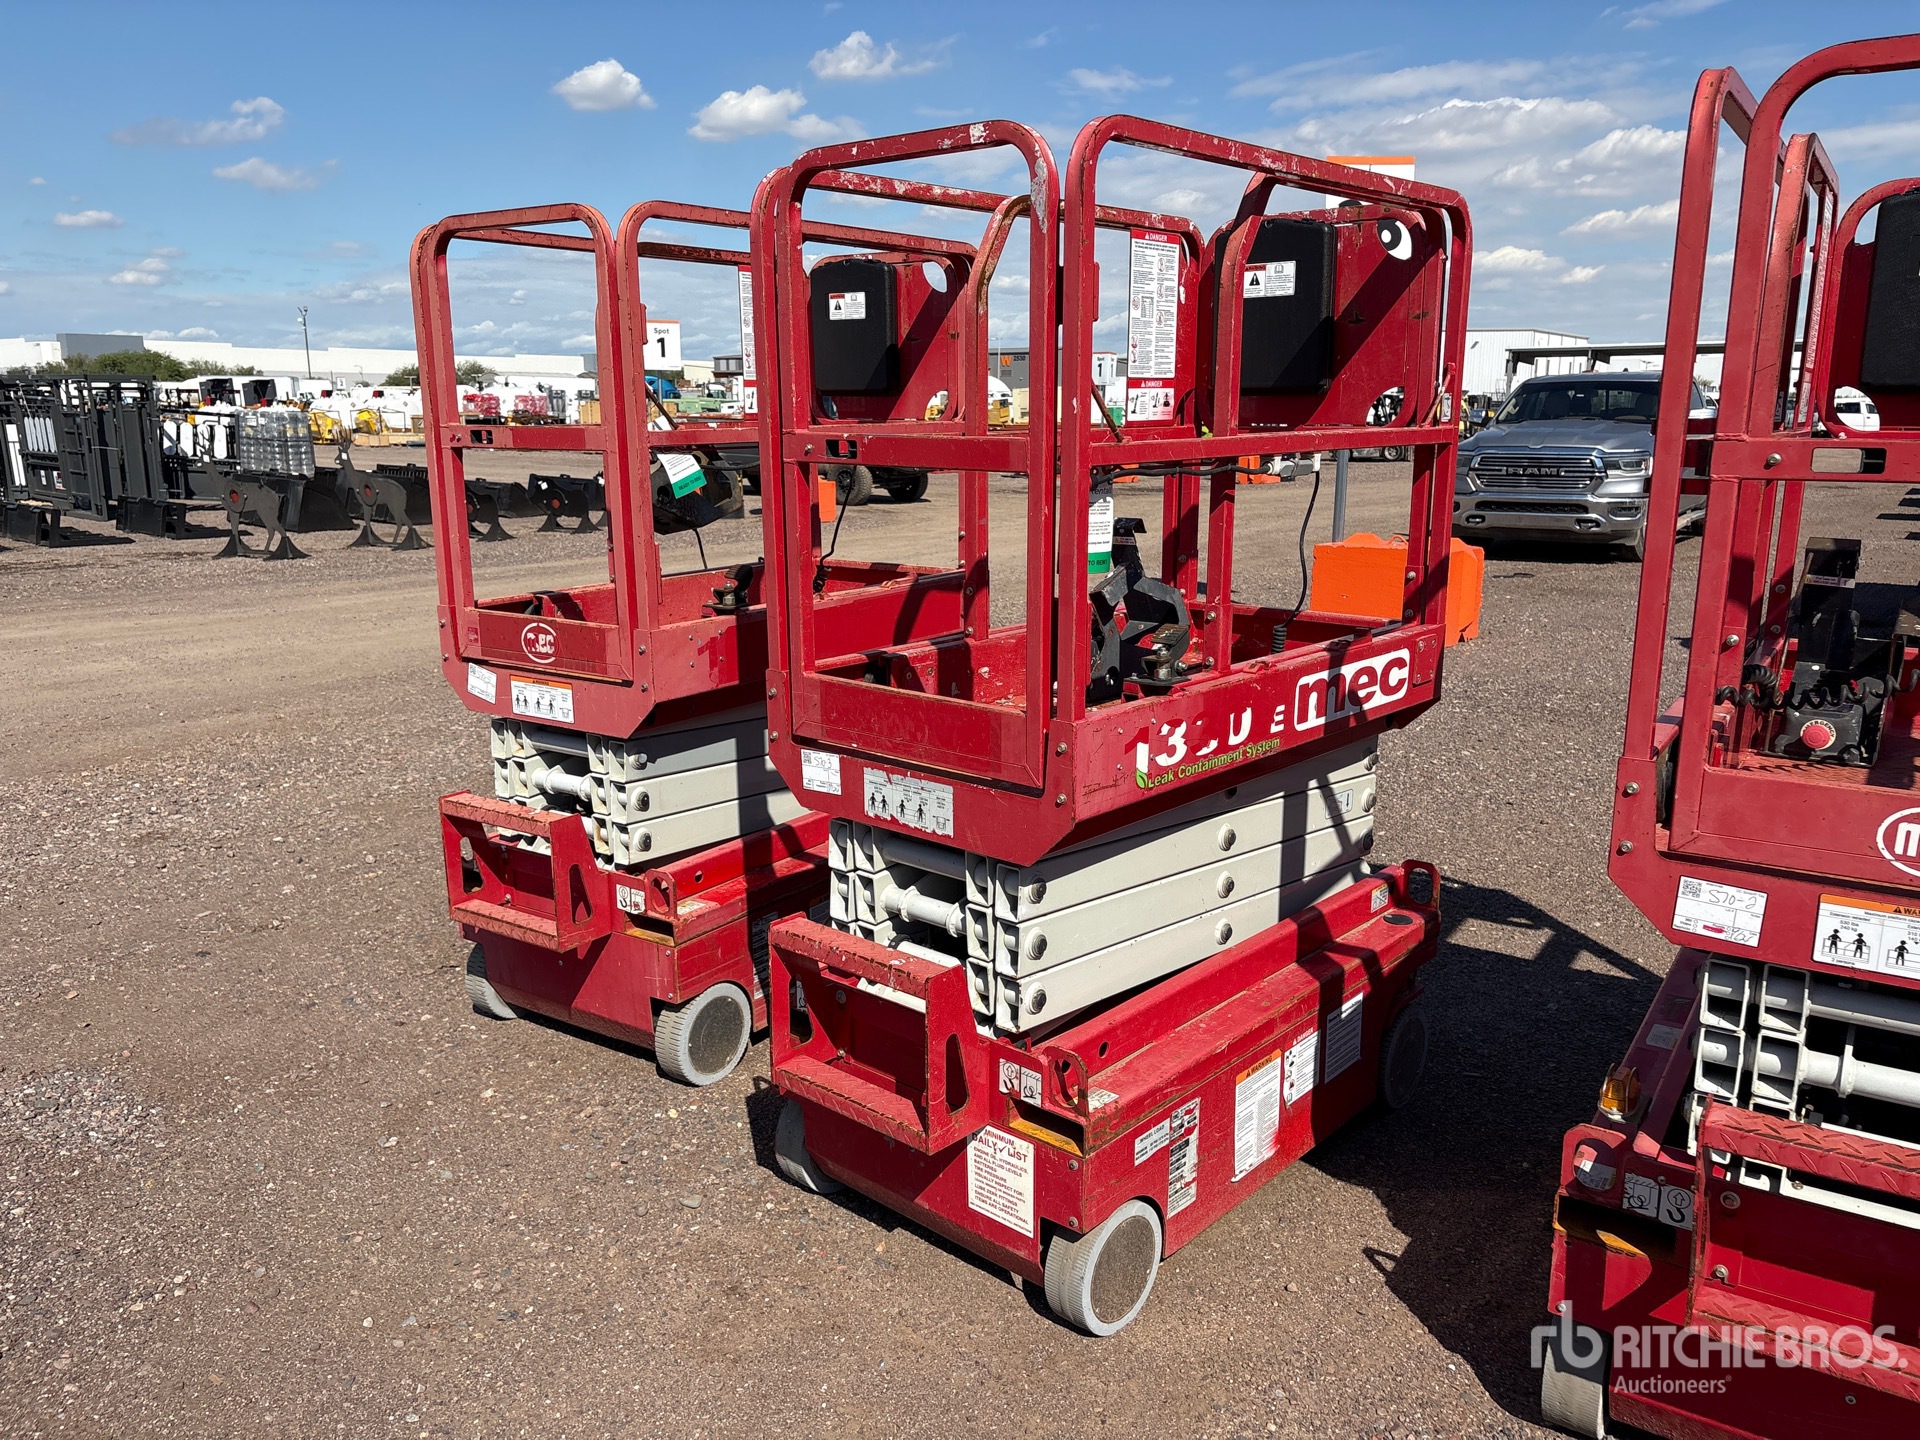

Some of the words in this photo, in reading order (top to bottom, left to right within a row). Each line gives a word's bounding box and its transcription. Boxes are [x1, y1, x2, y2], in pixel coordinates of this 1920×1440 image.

[1149, 233, 1168, 242] DANGER
[653, 327, 669, 335] Spot
[656, 337, 666, 358] 1
[1097, 362, 1103, 377] 1
[1507, 467, 1557, 475] RAM
[1297, 656, 1408, 725] mec
[1148, 770, 1175, 789] Leak
[1178, 747, 1244, 778] Containment
[1246, 738, 1281, 760] System
[1296, 1026, 1314, 1043] DANGER
[1250, 1055, 1273, 1075] WARNING
[984, 1129, 1015, 1146] MINIMUM
[1153, 1124, 1165, 1135] LOAD
[972, 1133, 997, 1149] DAILY
[1007, 1147, 1028, 1163] LIST
[973, 1146, 989, 1156] ENGINE
[973, 1152, 983, 1160] AND
[992, 1160, 1005, 1170] FLUID
[1005, 1166, 1022, 1178] LEVELS
[973, 1159, 997, 1172] BATTERIES
[974, 1171, 994, 1183] VISUALLY
[994, 1180, 1013, 1192] INSPECT
[984, 1168, 1007, 1183] PRESSURE
[974, 1183, 986, 1192] LUBE
[986, 1188, 998, 1197] ZERK
[998, 1194, 1018, 1207] FITTINGS
[974, 1189, 992, 1202] ENSURE
[992, 1198, 1001, 1206] ALL
[1001, 1202, 1019, 1213] SAFETY
[974, 1195, 988, 1205] ITEMS
[988, 1202, 998, 1210] ARE
[998, 1206, 1029, 1225] OPERATIONAL
